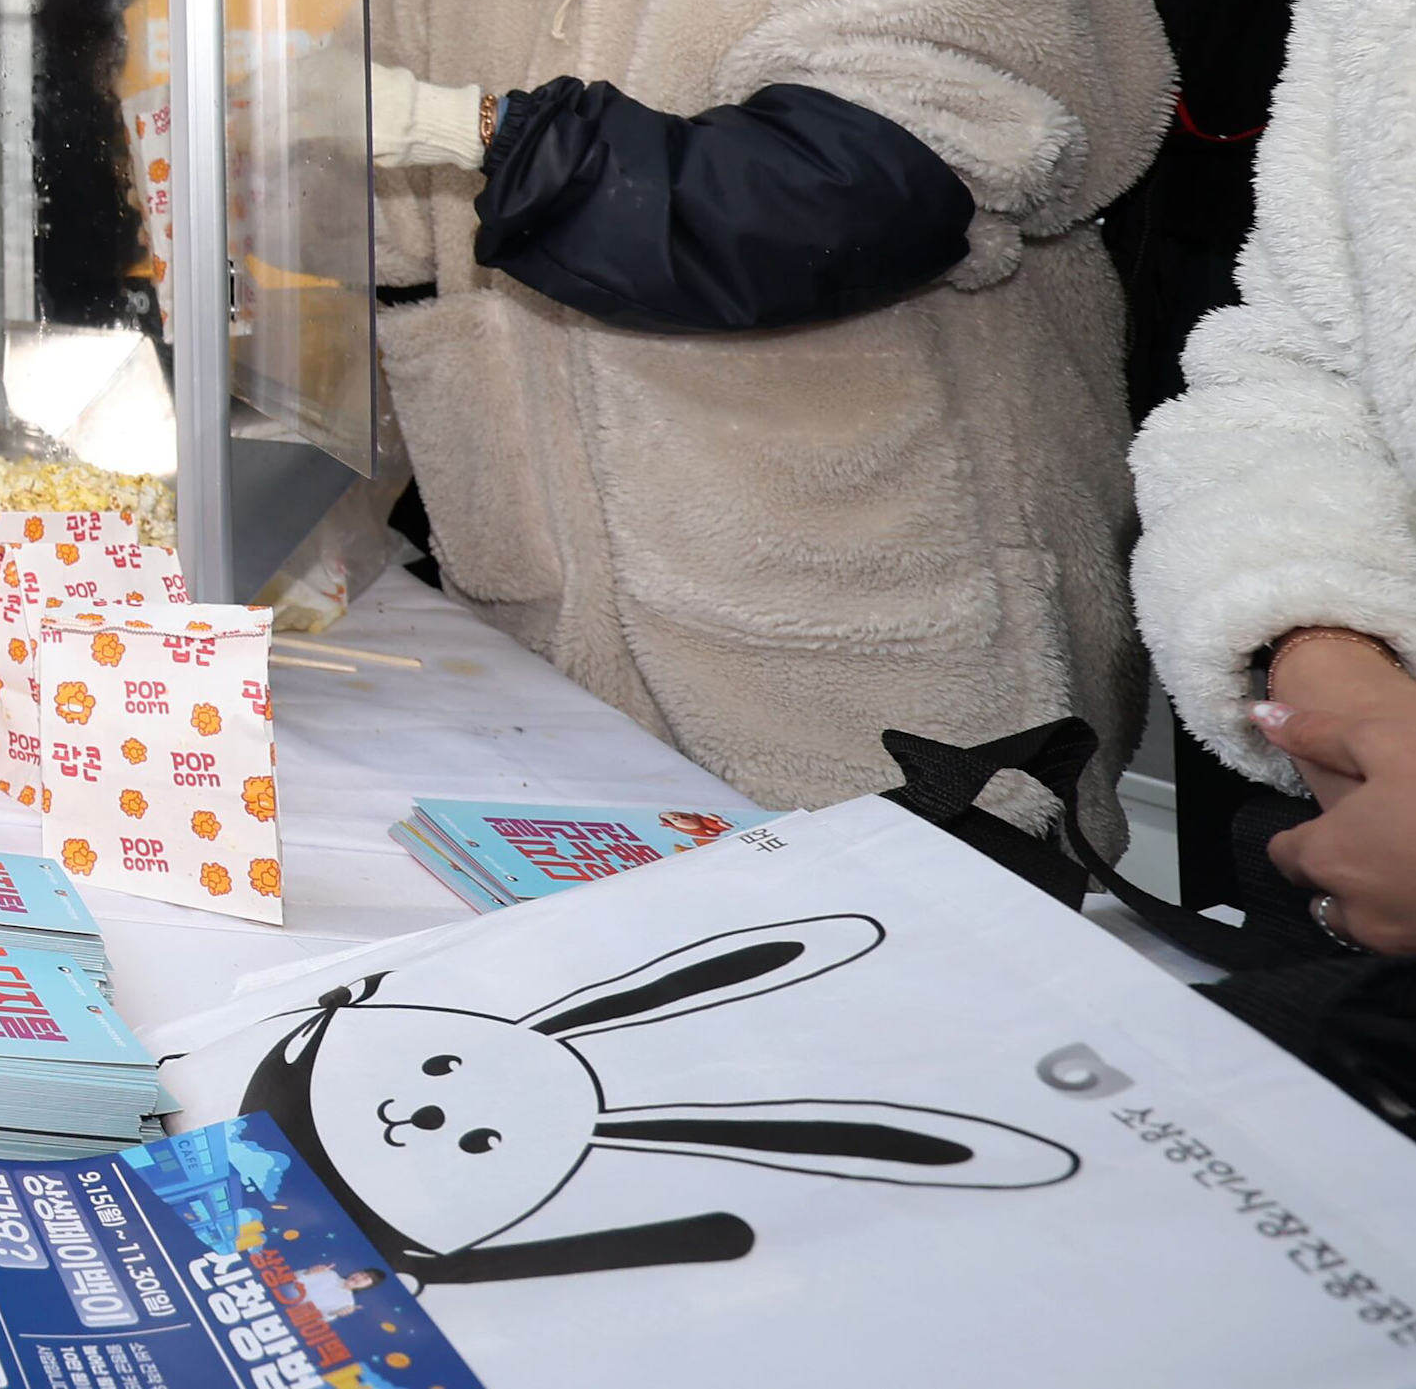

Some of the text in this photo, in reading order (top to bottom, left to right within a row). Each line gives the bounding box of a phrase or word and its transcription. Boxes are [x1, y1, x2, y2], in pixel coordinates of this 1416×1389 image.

[66, 511, 103, 543] 팝콘
[64, 581, 98, 599] POP
[123, 680, 167, 699] POP
[125, 699, 170, 716] corn
[7, 730, 41, 752] POP
[8, 748, 41, 767] corn
[51, 741, 102, 783] 팝콘
[170, 751, 217, 772] POP
[173, 772, 222, 788] corn
[119, 836, 164, 857] POP
[122, 857, 170, 874] corn
[176, 1138, 200, 1171] CAFE
[21, 1174, 132, 1322] 상생페이백이
[77, 1170, 177, 1318] 9.15(월) 11.30(일)
